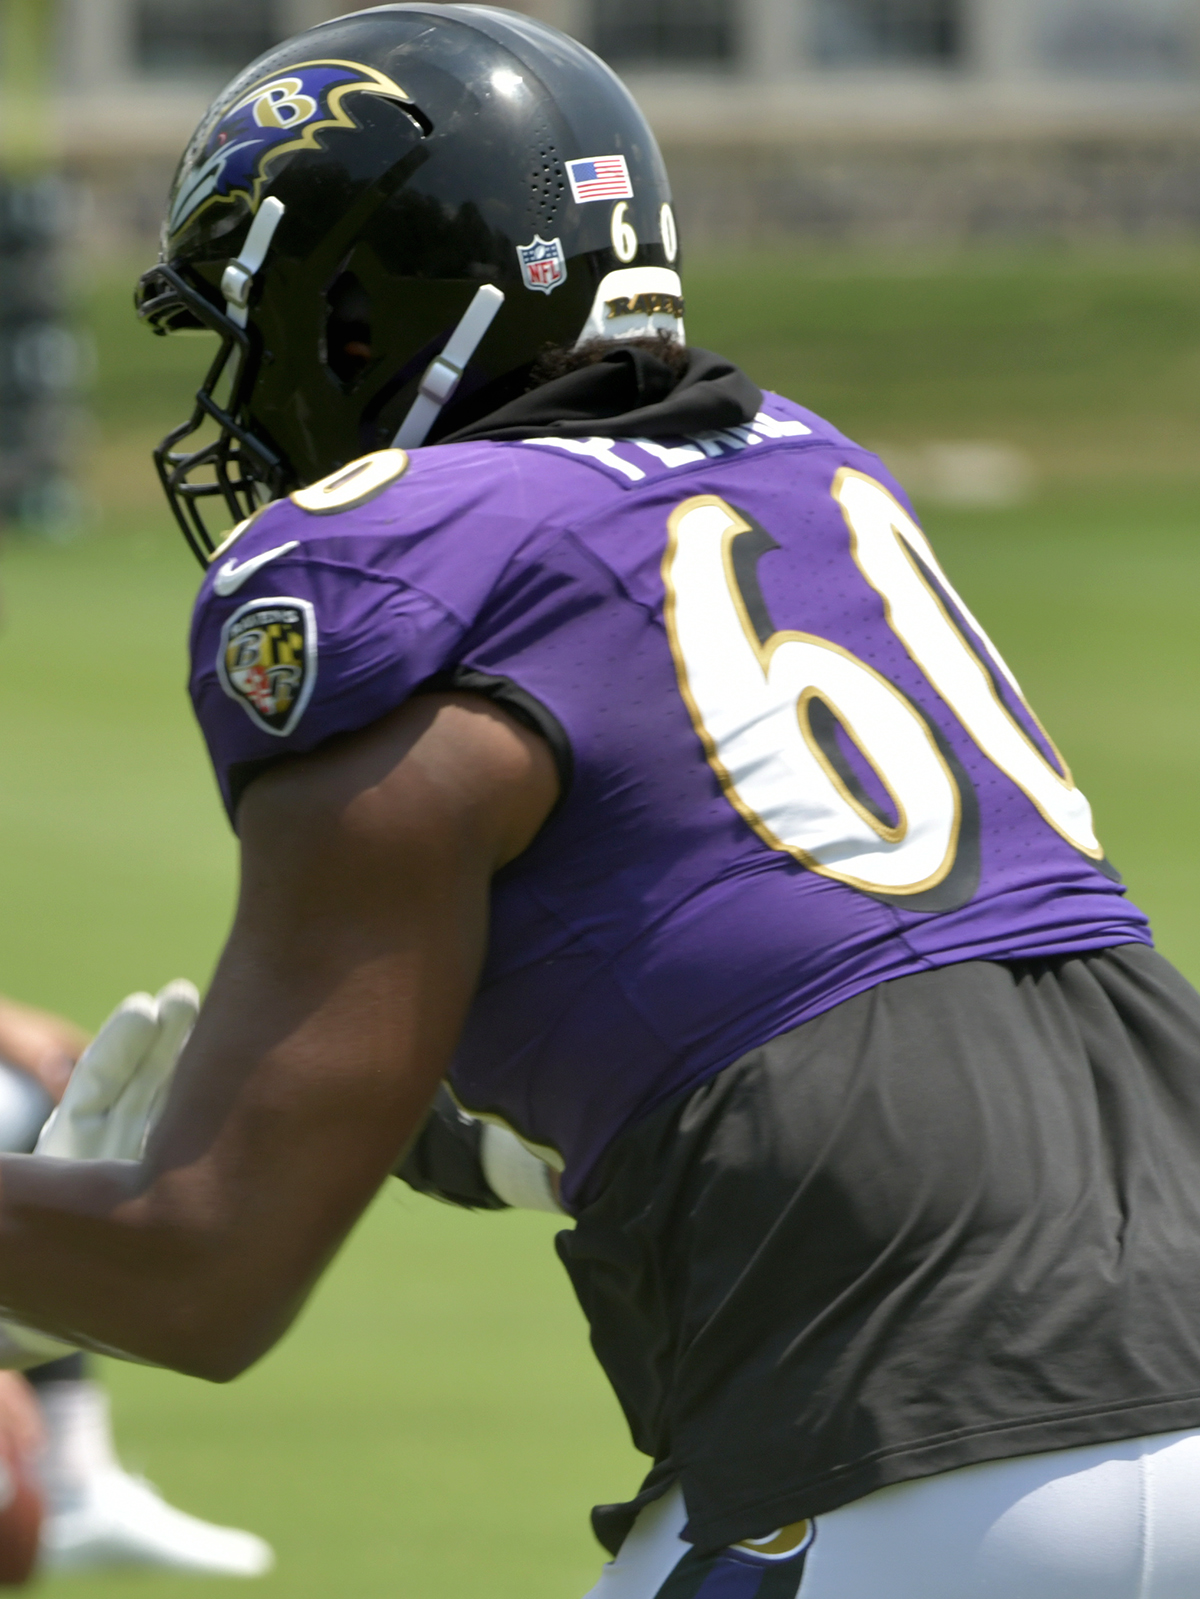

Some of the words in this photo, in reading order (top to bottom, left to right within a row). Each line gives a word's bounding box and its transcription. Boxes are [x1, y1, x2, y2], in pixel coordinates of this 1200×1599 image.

[225, 77, 318, 129] B
[611, 201, 677, 263] 60
[527, 260, 561, 284] NFL
[661, 466, 1104, 896] 60
